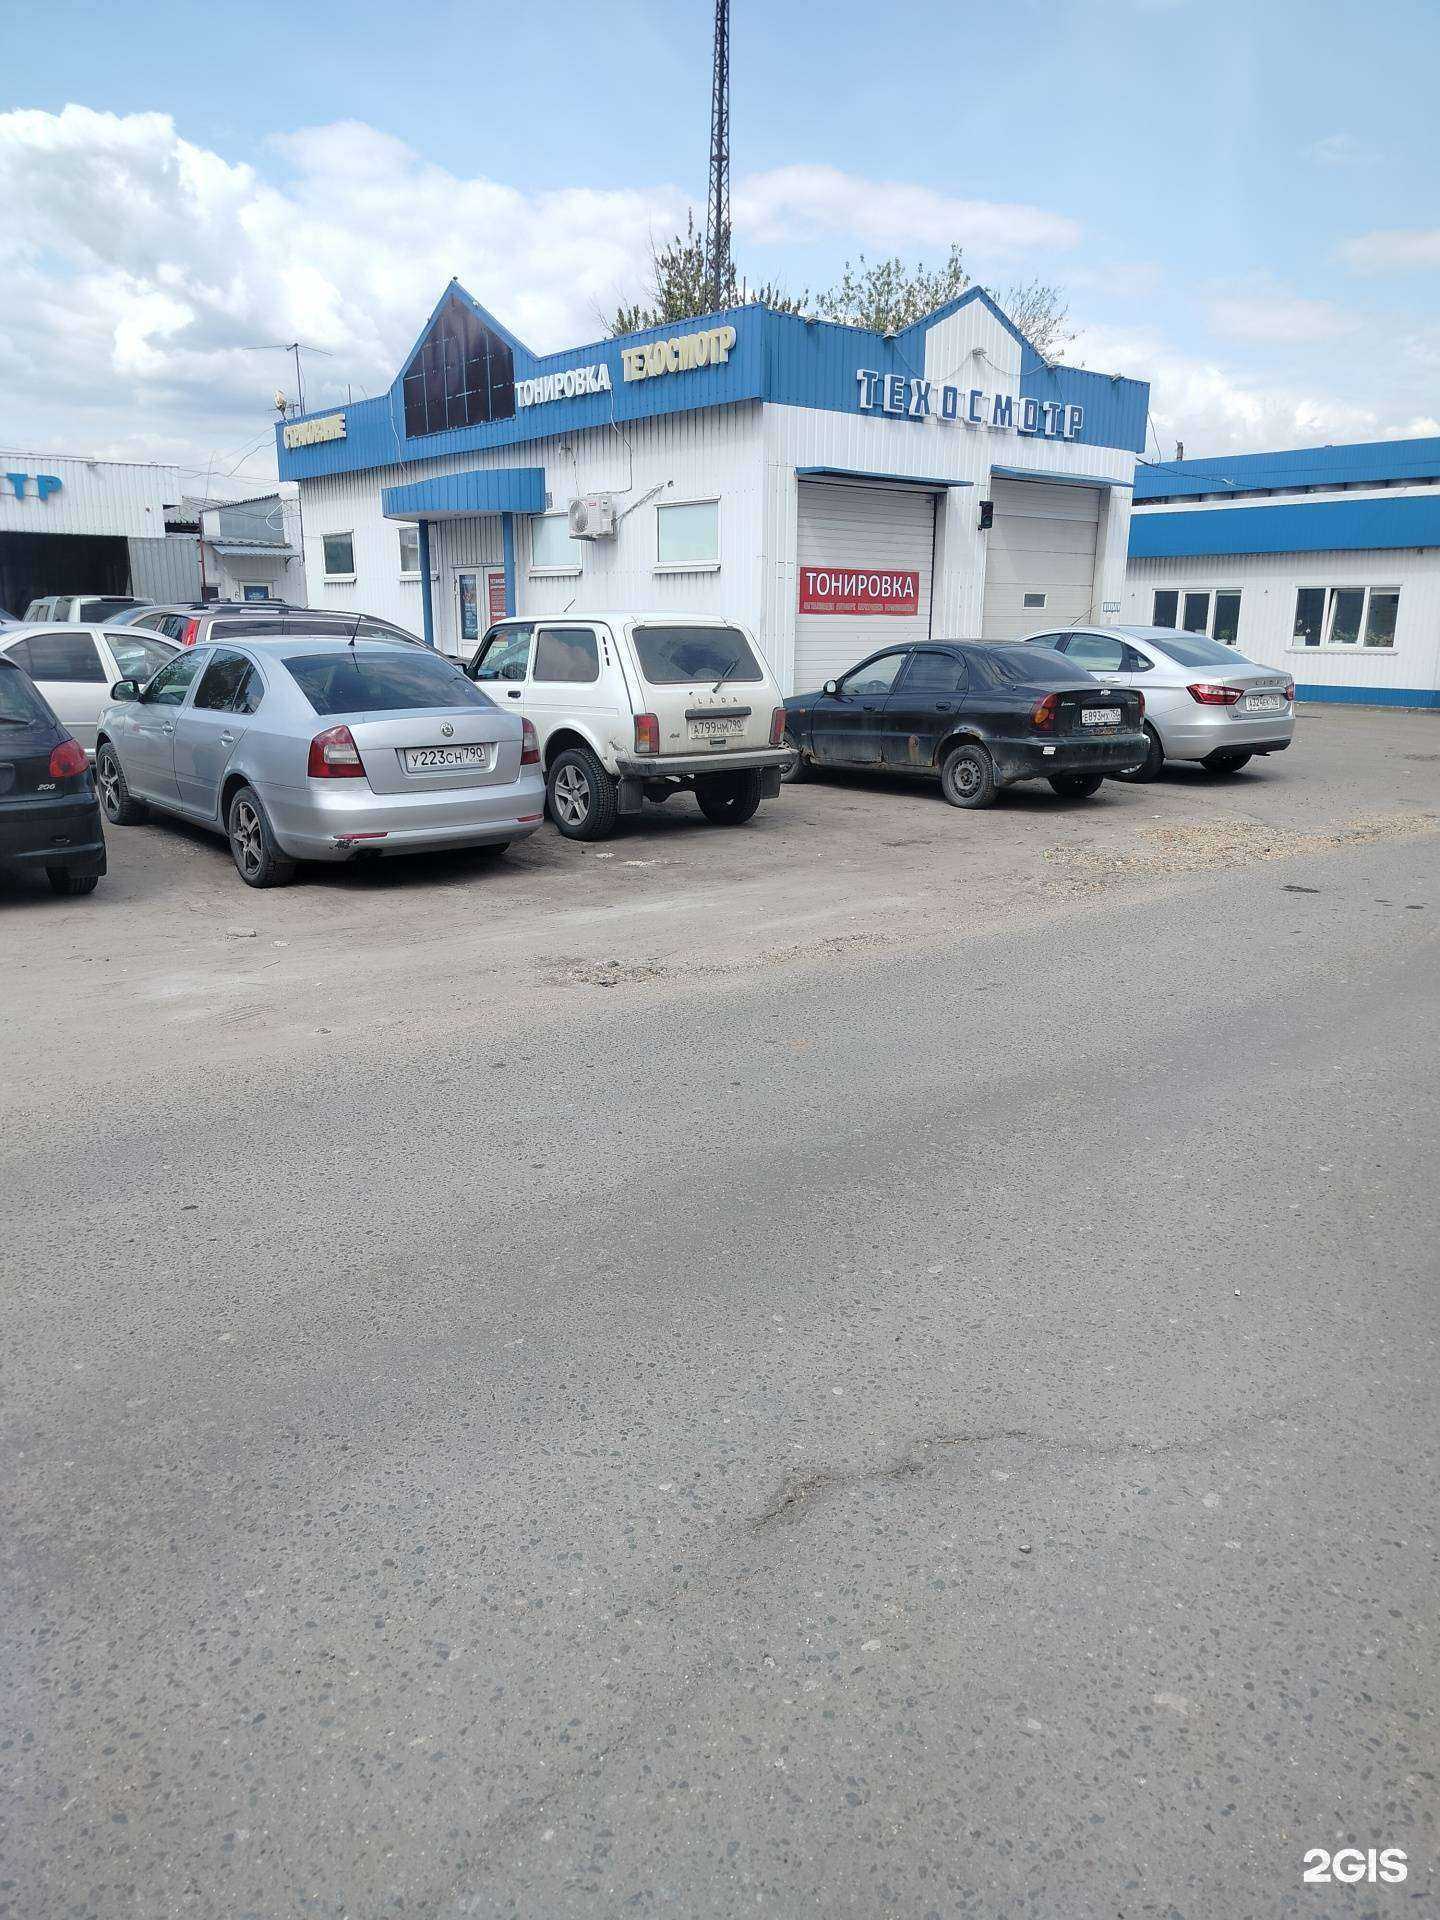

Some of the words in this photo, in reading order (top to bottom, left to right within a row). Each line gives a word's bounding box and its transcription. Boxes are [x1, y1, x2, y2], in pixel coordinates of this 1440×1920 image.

[621, 326, 737, 382] ТЕХОСМОТР
[515, 364, 612, 407] ТОНИРОВКА
[857, 368, 1084, 439] ТЕХОСМОТР
[806, 572, 914, 598] ТОНИРОВКА
[698, 696, 738, 704] LADA
